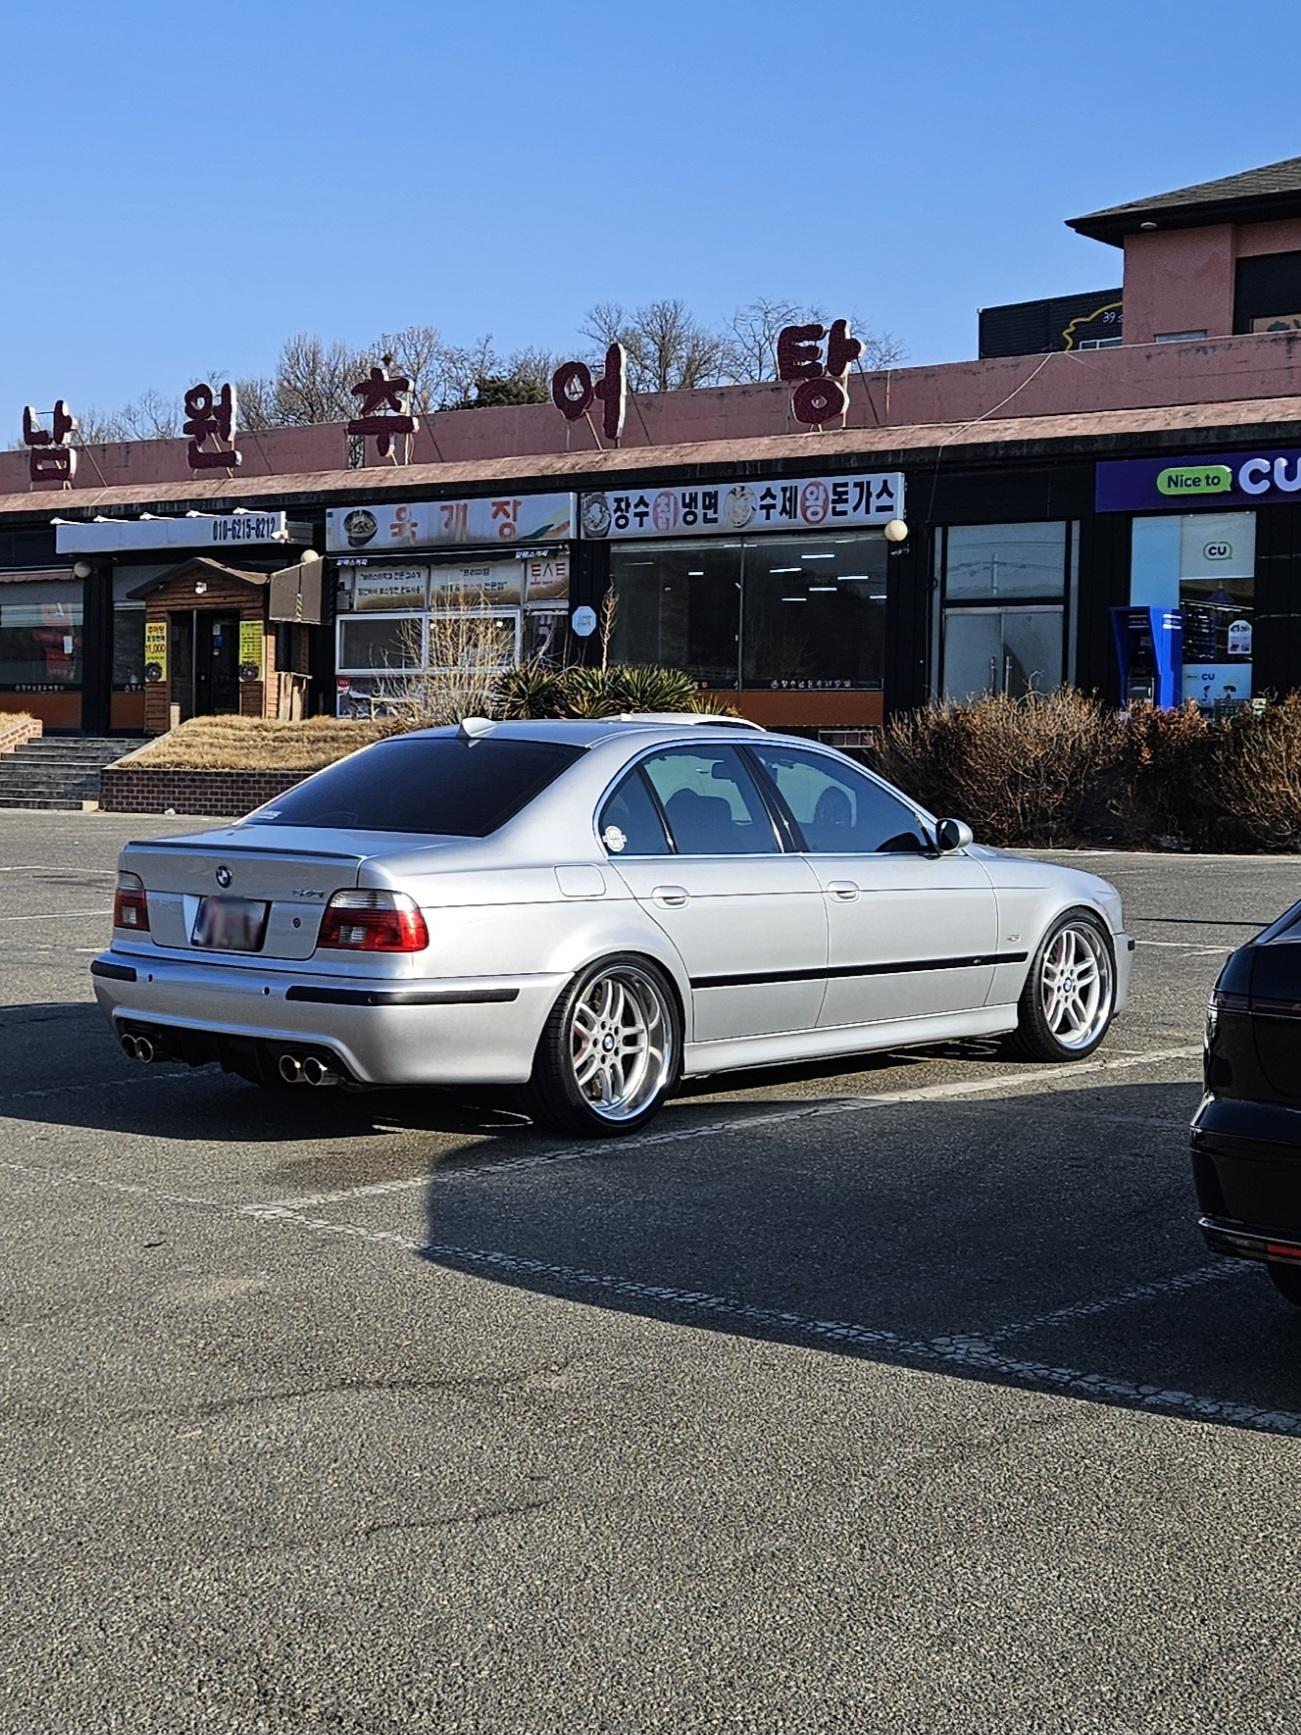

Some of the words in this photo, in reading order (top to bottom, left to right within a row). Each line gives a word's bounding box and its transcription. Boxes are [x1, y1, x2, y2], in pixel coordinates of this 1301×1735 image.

[1103, 311, 1116, 323] 39
[1167, 475, 1202, 488] Nice
[1204, 474, 1221, 486] to
[1238, 457, 1301, 495] CU
[212, 517, 276, 541] 010-6215-8212
[1208, 546, 1227, 556] CU
[530, 562, 566, 586] 토스트
